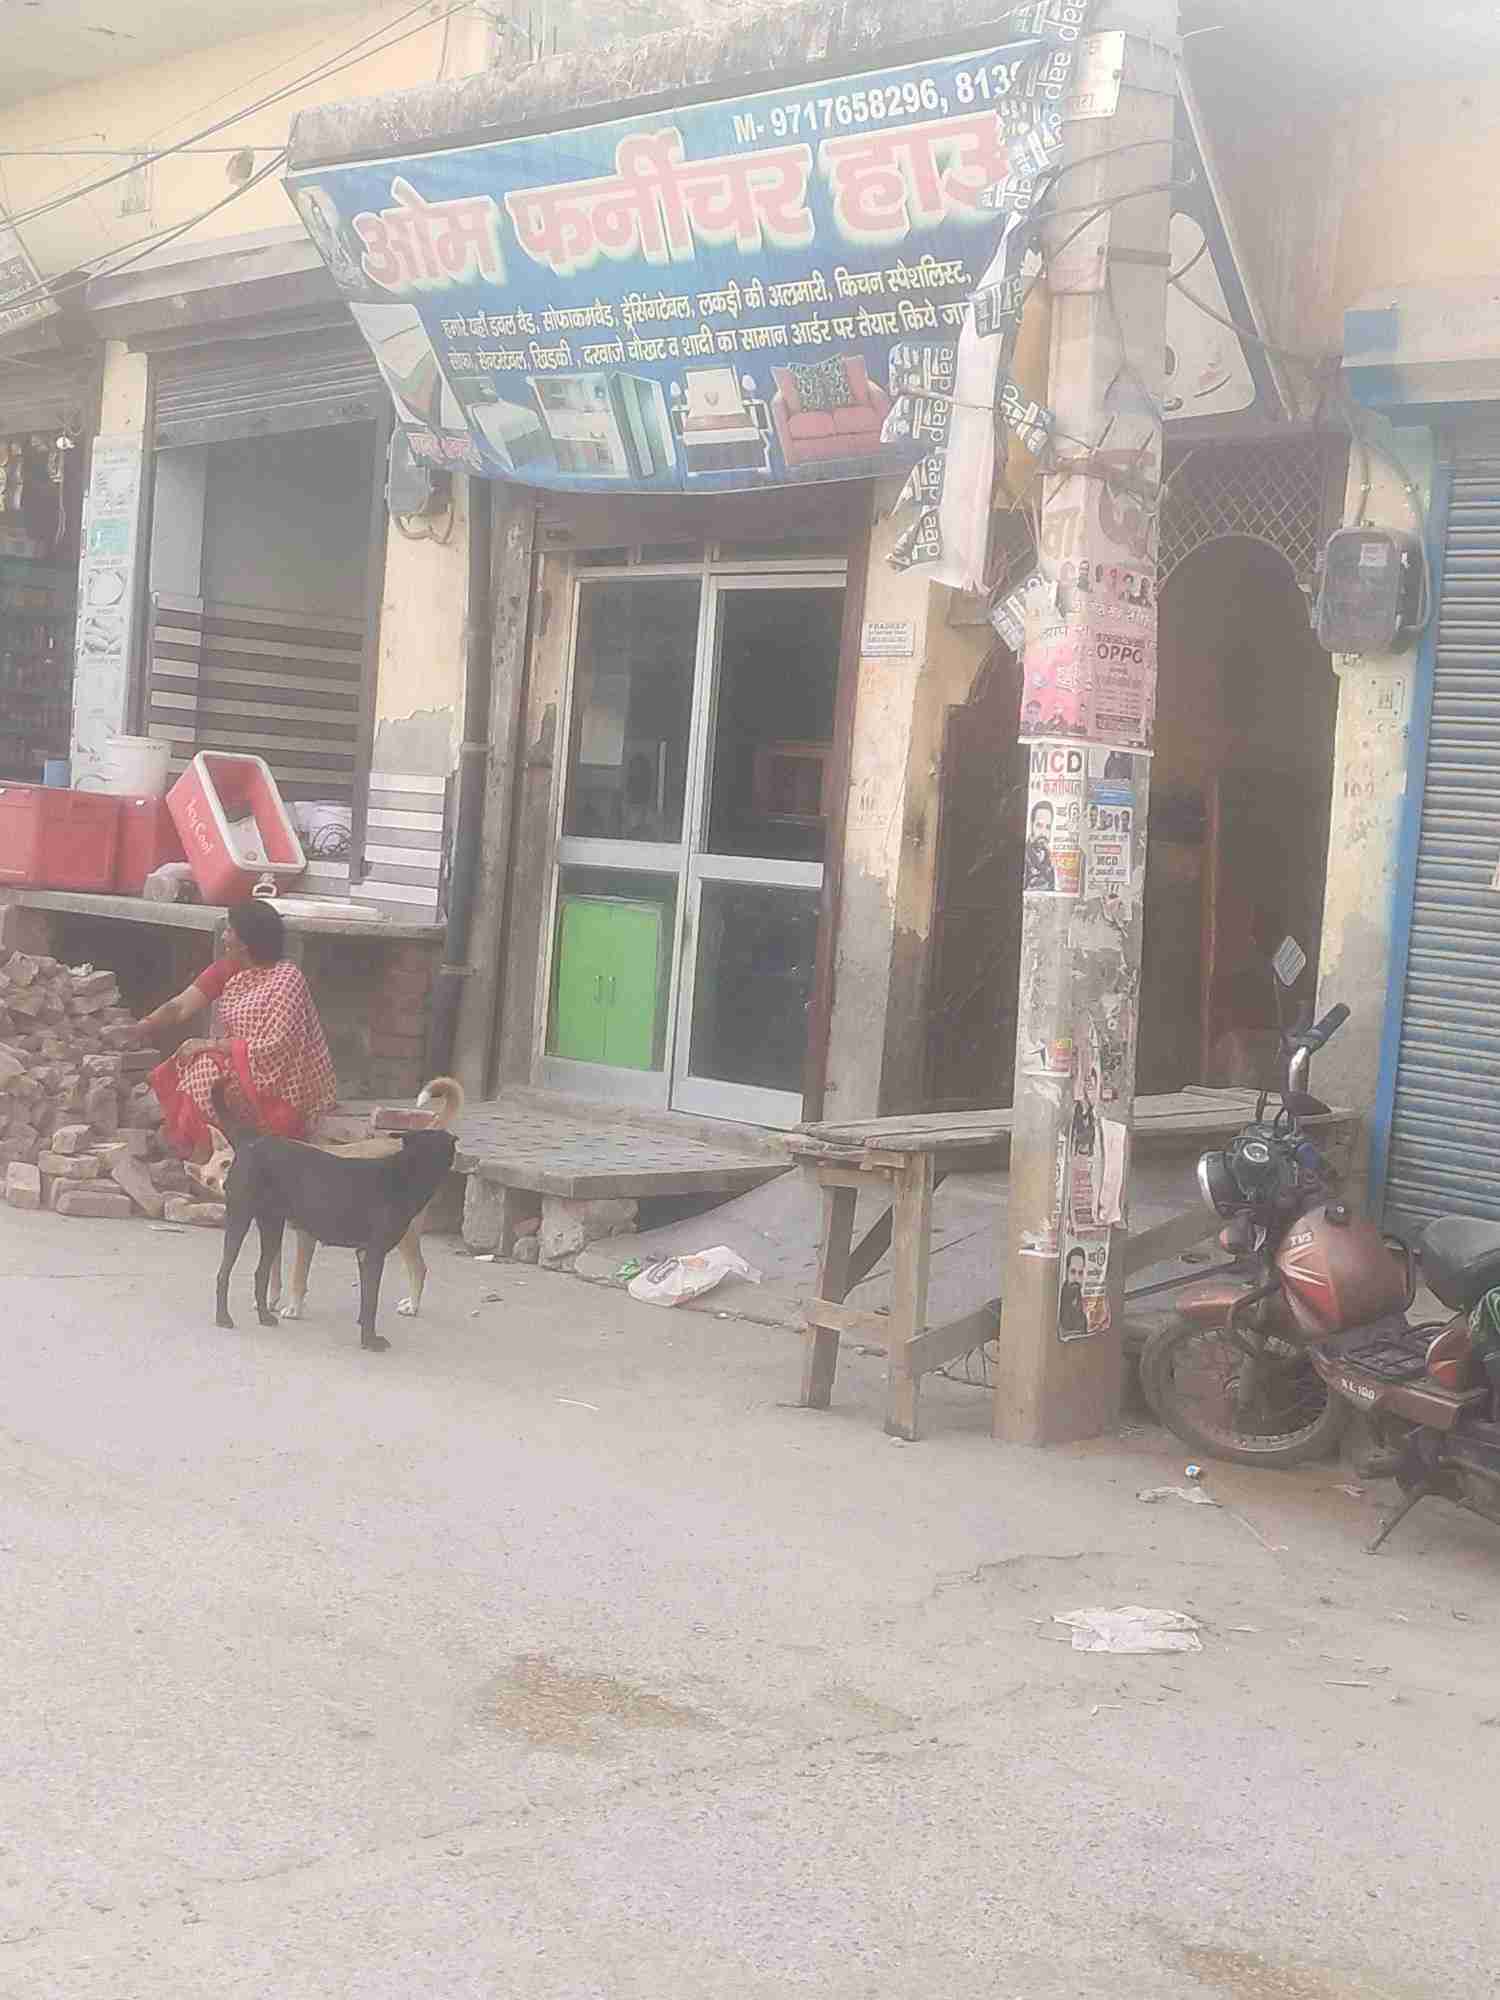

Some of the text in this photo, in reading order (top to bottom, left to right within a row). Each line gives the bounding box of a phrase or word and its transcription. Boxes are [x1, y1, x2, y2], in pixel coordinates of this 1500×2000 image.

[1037, 51, 1072, 99] aap
[770, 78, 949, 136] 9717658296,
[352, 176, 504, 290] ओम
[696, 280, 742, 320] लकड़ी
[743, 277, 767, 309] की
[768, 269, 834, 308] अलमारी,
[834, 265, 886, 299] किचन
[580, 335, 627, 366] दरवाजे
[626, 332, 668, 362] चौखट
[668, 337, 680, 360] व
[681, 324, 715, 357] शादी
[715, 330, 738, 353] का
[738, 325, 789, 352] सामान
[790, 312, 832, 346] आर्डर
[831, 317, 857, 341] पर
[897, 299, 939, 333] किये
[930, 347, 954, 390] aap
[920, 399, 949, 442] aap
[911, 514, 941, 558] aap
[1031, 750, 1083, 773] MCD
[1290, 1231, 1313, 1247] TVS
